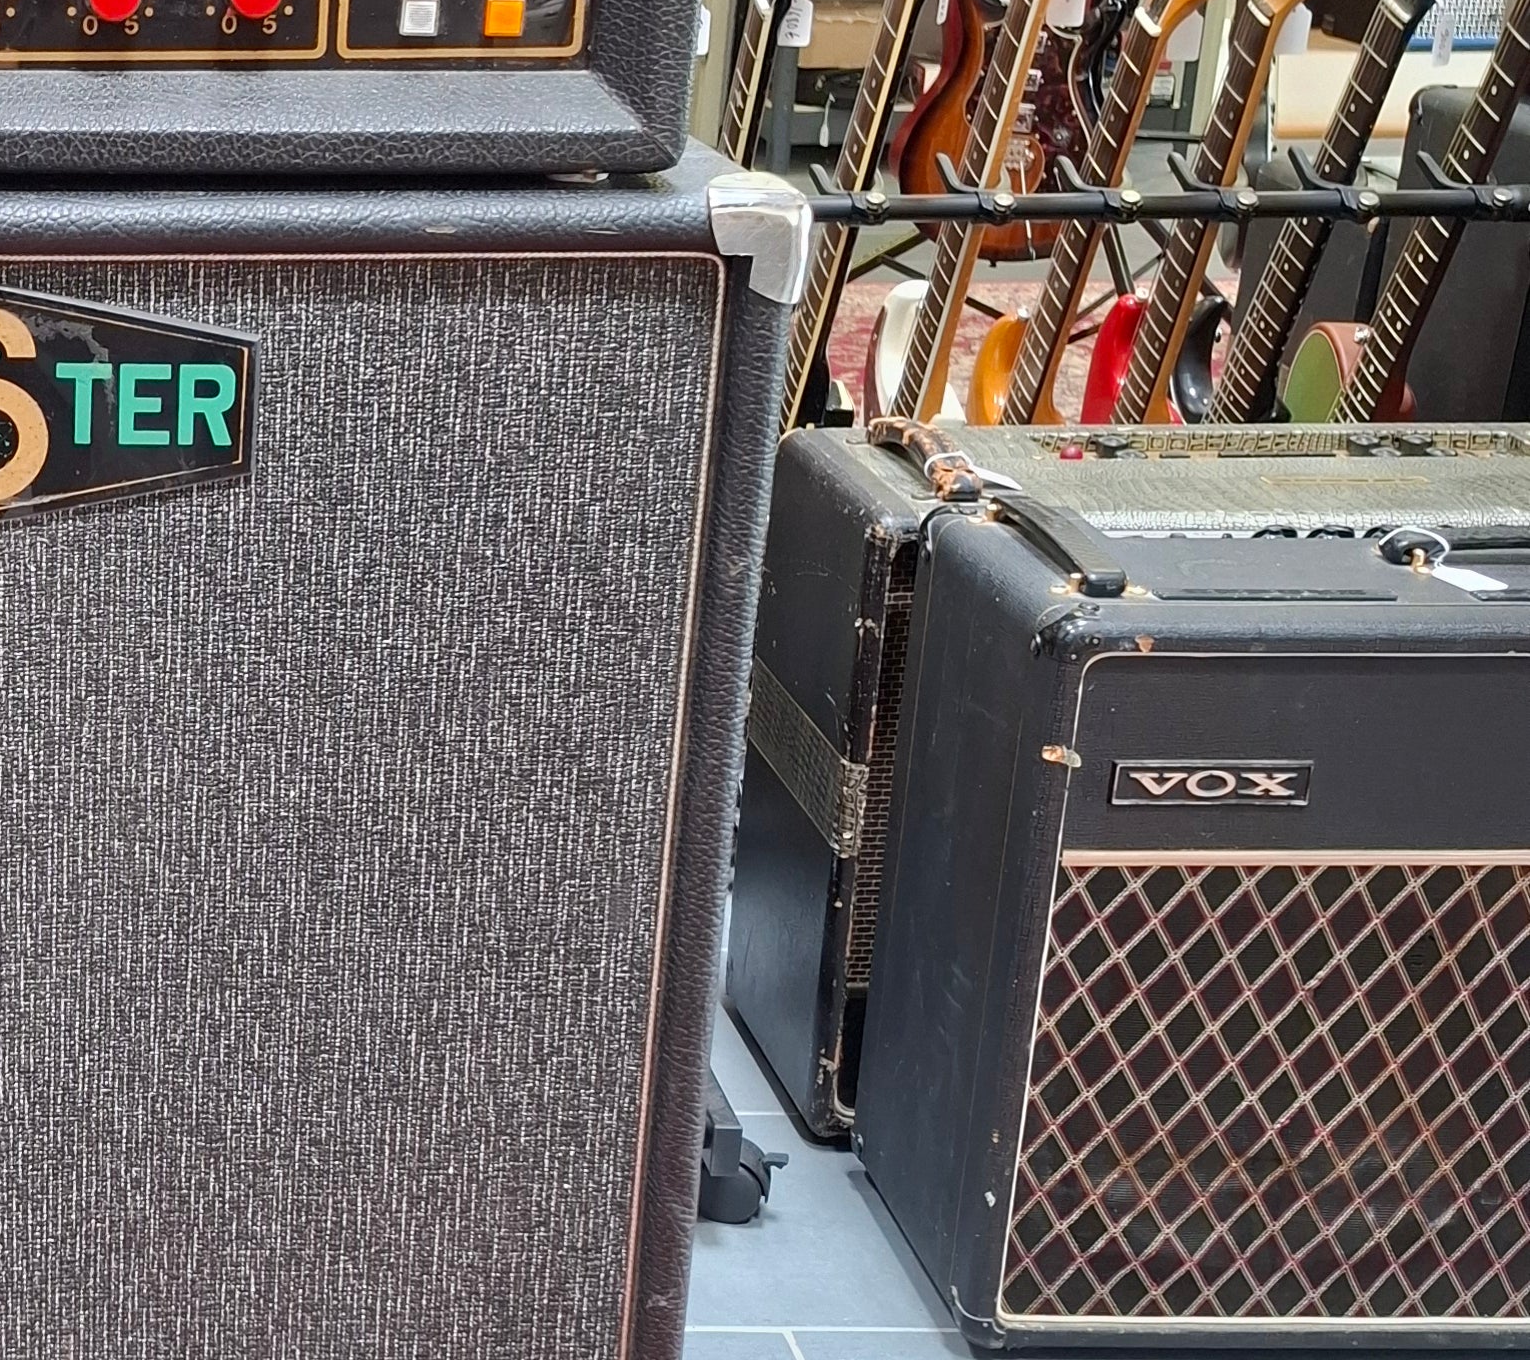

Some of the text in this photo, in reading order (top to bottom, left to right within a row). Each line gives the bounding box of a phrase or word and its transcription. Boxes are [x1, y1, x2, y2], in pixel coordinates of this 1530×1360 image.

[82, 15, 98, 35] 0
[124, 15, 139, 35] 5
[221, 14, 237, 34] 0
[262, 14, 277, 34] 5
[1127, 769, 1296, 798] VOX
